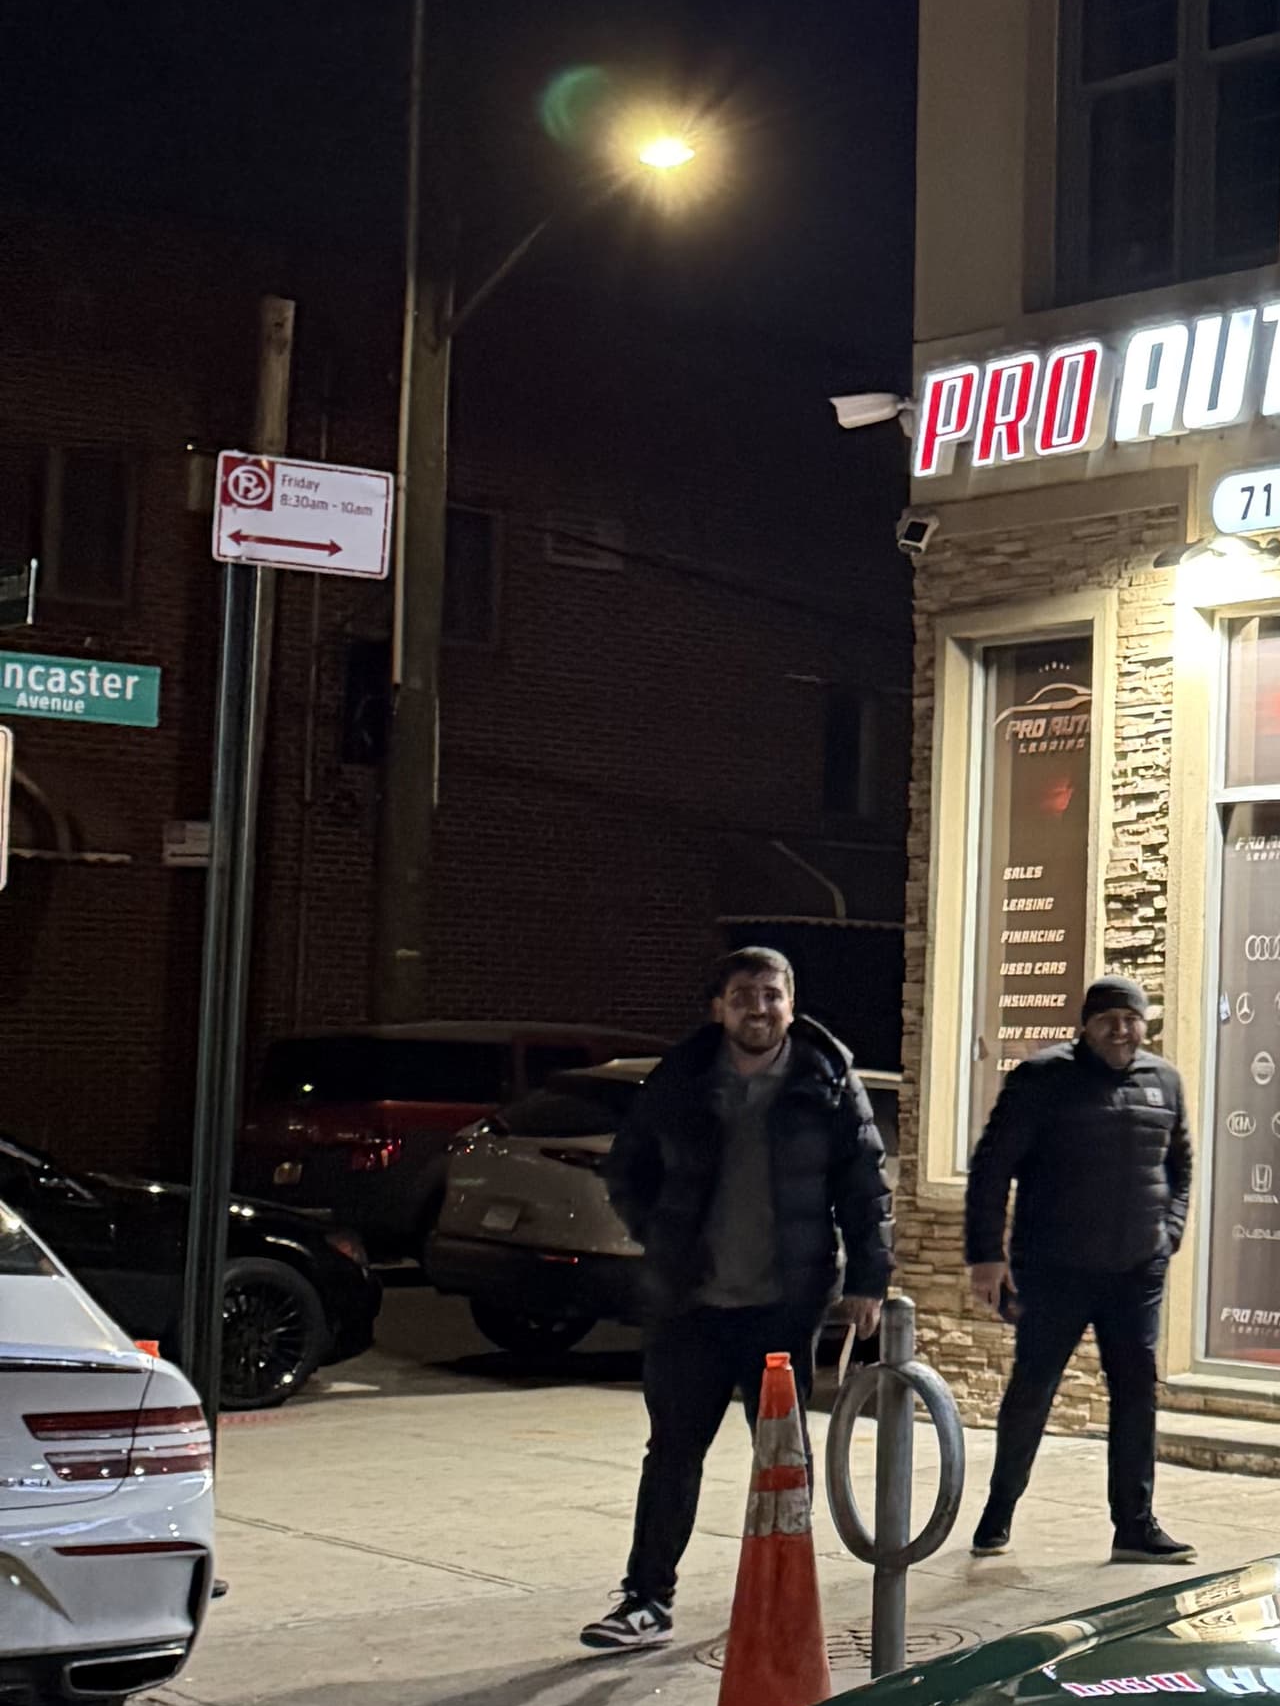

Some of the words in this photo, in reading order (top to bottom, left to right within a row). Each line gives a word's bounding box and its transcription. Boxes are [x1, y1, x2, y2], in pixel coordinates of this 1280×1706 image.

[914, 339, 1106, 478] PRO
[281, 473, 320, 492] Friday
[280, 494, 329, 511] 8:30am
[341, 503, 373, 516] 10am
[4, 661, 140, 700] ncaster
[16, 692, 86, 714] Avenue
[1049, 714, 1090, 738] AUT
[1003, 866, 1043, 880] SALES
[1002, 897, 1054, 911] LEASING
[1000, 929, 1065, 944] FINANCING
[1000, 962, 1032, 975] USED
[1033, 962, 1067, 974] CARS
[999, 994, 1067, 1007] INSURANCE
[998, 1026, 1023, 1039] DMV
[1024, 1026, 1076, 1039] SERVICE
